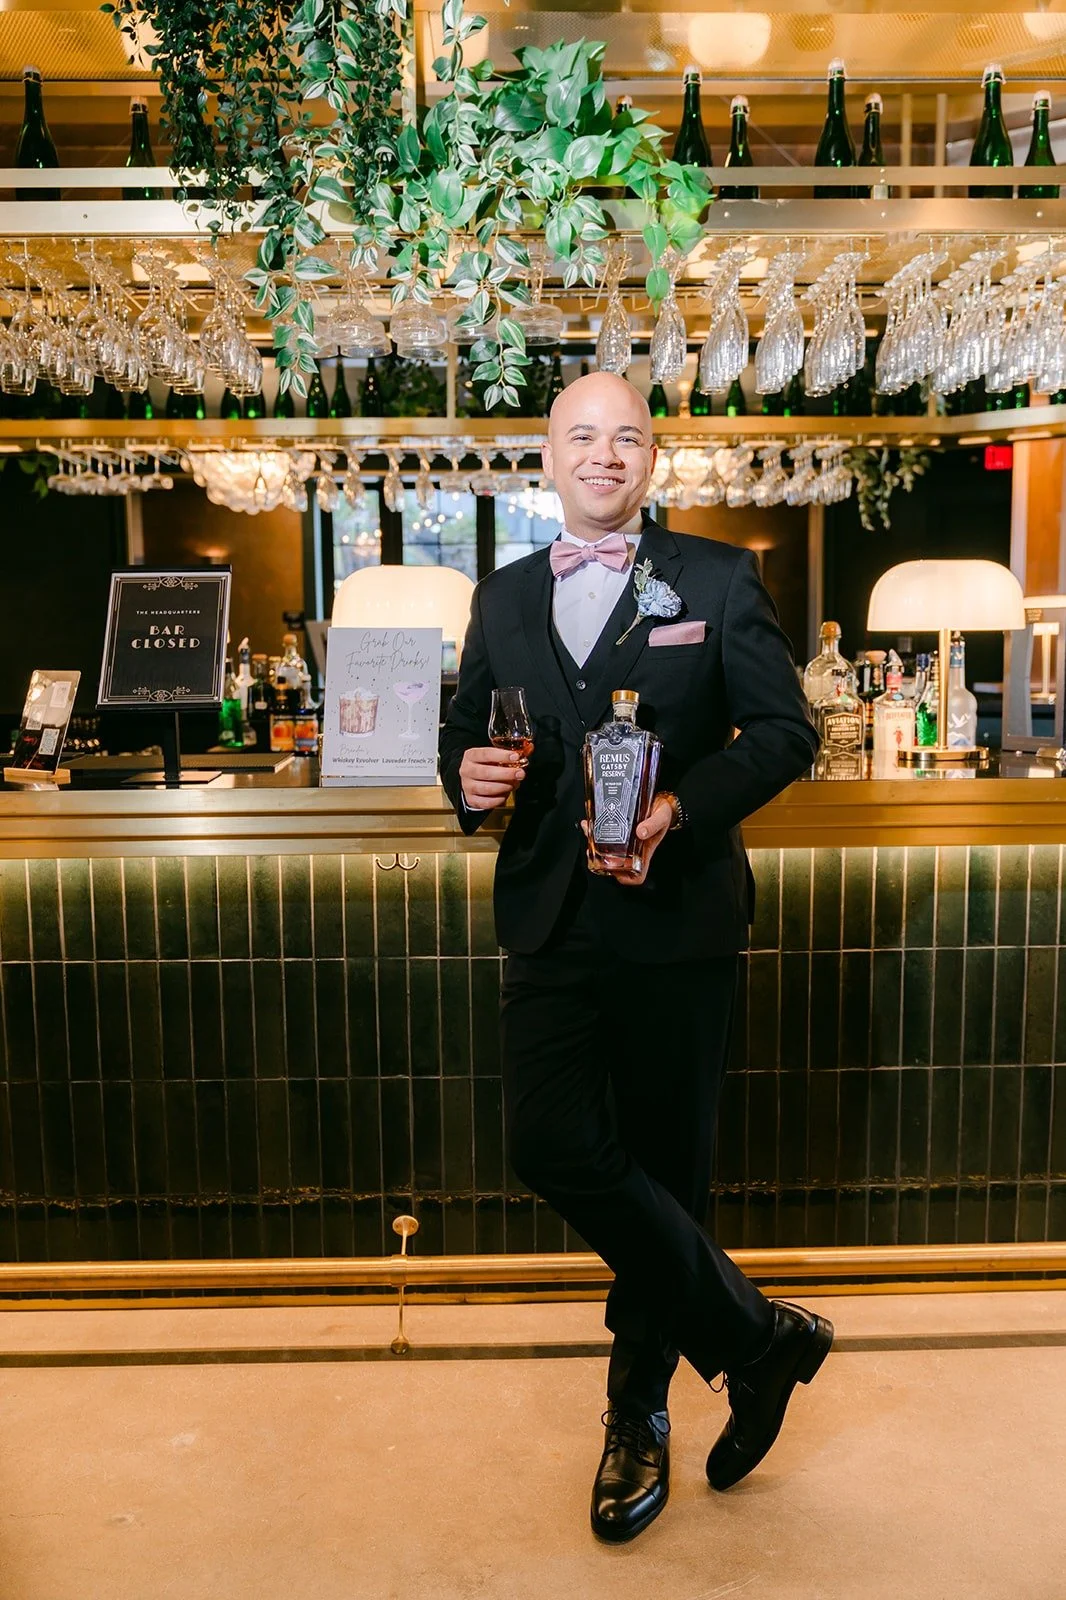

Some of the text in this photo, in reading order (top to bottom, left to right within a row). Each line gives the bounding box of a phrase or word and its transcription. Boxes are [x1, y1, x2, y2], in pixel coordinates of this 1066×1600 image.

[149, 625, 185, 635] BAR
[131, 638, 200, 649] CLOSED
[360, 631, 416, 653] Grab Our
[345, 651, 389, 674] Favorite
[599, 753, 630, 763] REMUS
